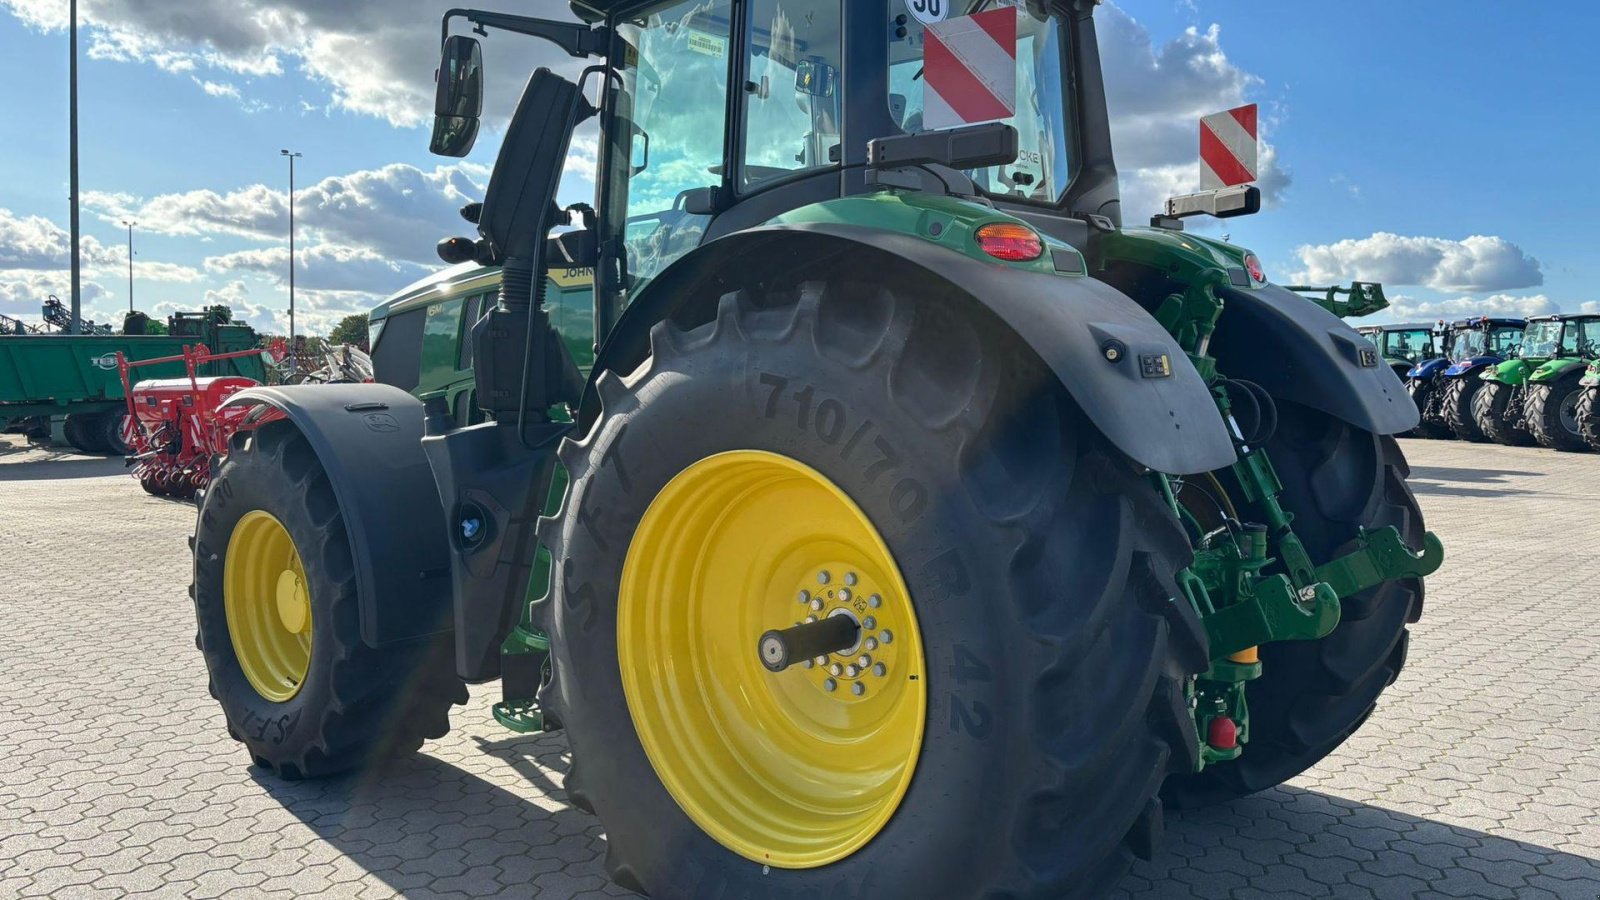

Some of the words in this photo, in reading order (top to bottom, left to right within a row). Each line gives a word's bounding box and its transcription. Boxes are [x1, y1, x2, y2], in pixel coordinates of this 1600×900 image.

[562, 266, 594, 279] JOHN
[213, 477, 233, 508] 30
[759, 372, 929, 524] 710/70
[923, 548, 972, 604] R
[949, 643, 994, 740] 42
